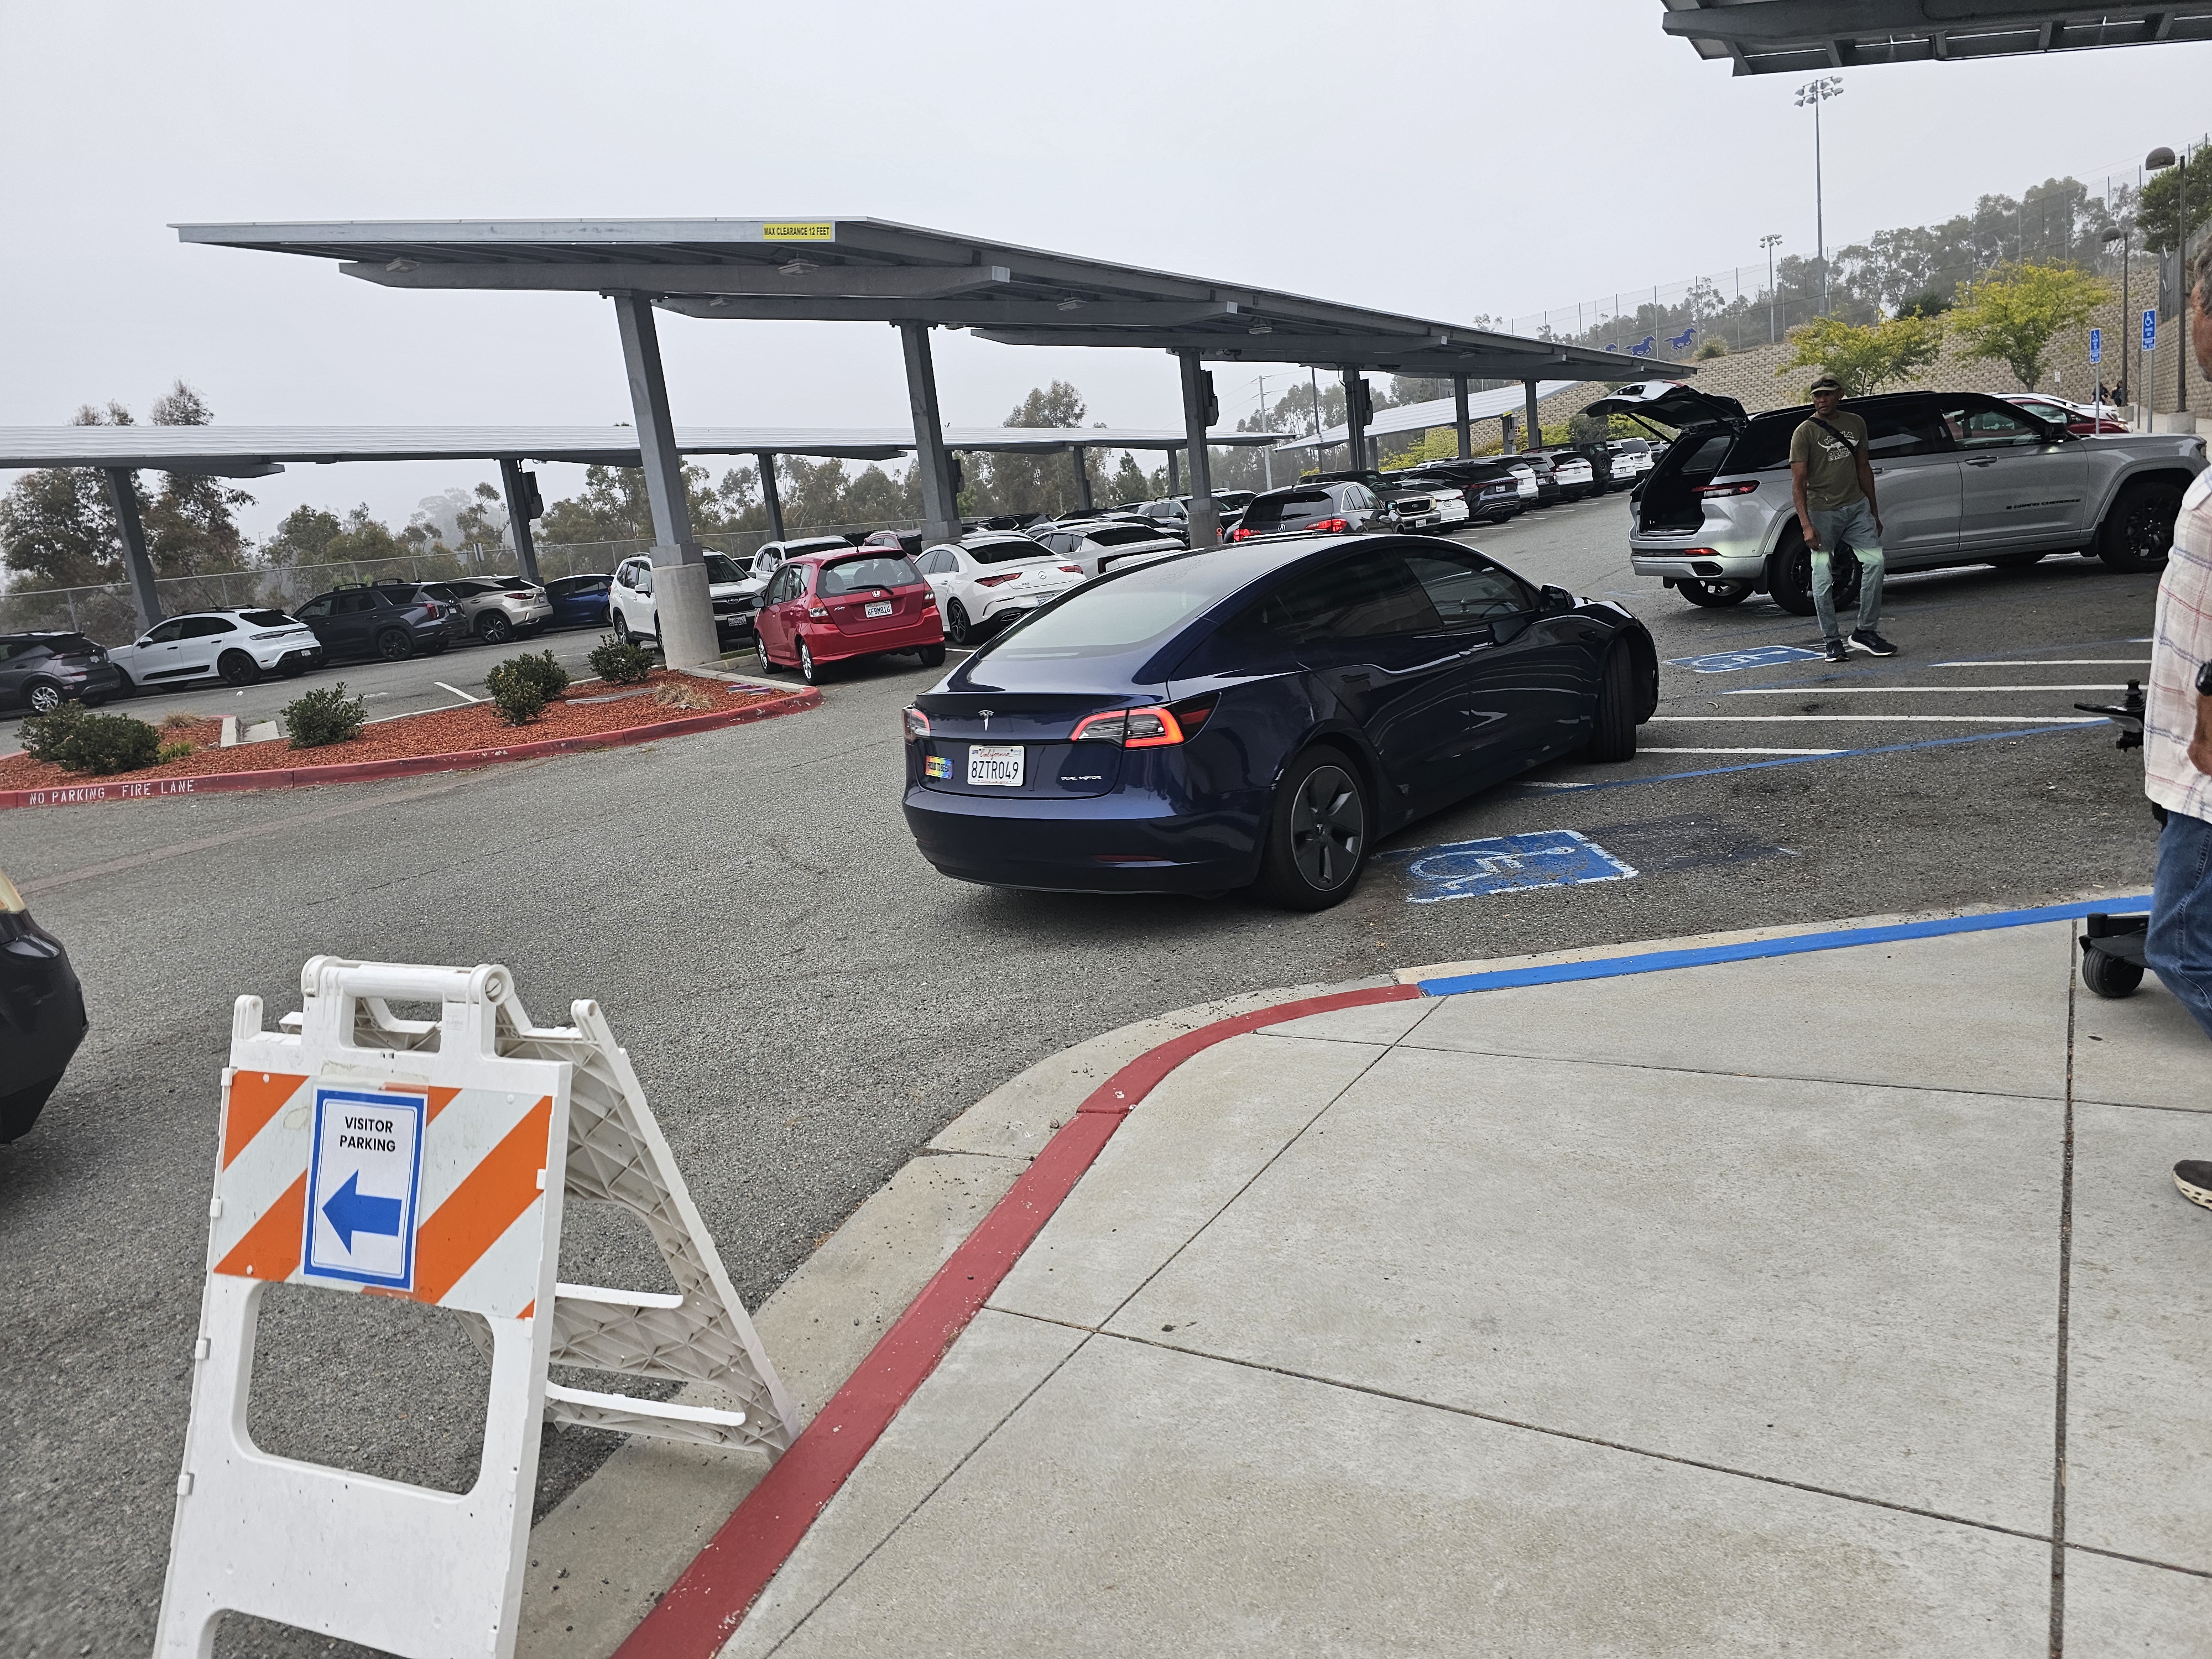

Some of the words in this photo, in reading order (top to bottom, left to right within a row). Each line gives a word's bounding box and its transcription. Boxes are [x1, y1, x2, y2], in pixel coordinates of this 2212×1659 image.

[764, 227, 775, 236] MAX
[776, 227, 807, 236] CLEARANCE
[809, 227, 815, 236] 12
[817, 227, 830, 236] FEET
[868, 606, 890, 616] 6FBM816
[980, 749, 1011, 760] California
[971, 760, 1019, 780] 8ZTR049
[30, 792, 44, 805] NO
[52, 787, 105, 802] PARKING
[122, 782, 151, 797] FIRE
[161, 779, 194, 794] LANE
[345, 1117, 393, 1133] VISITOR
[340, 1135, 395, 1152] PARKING
